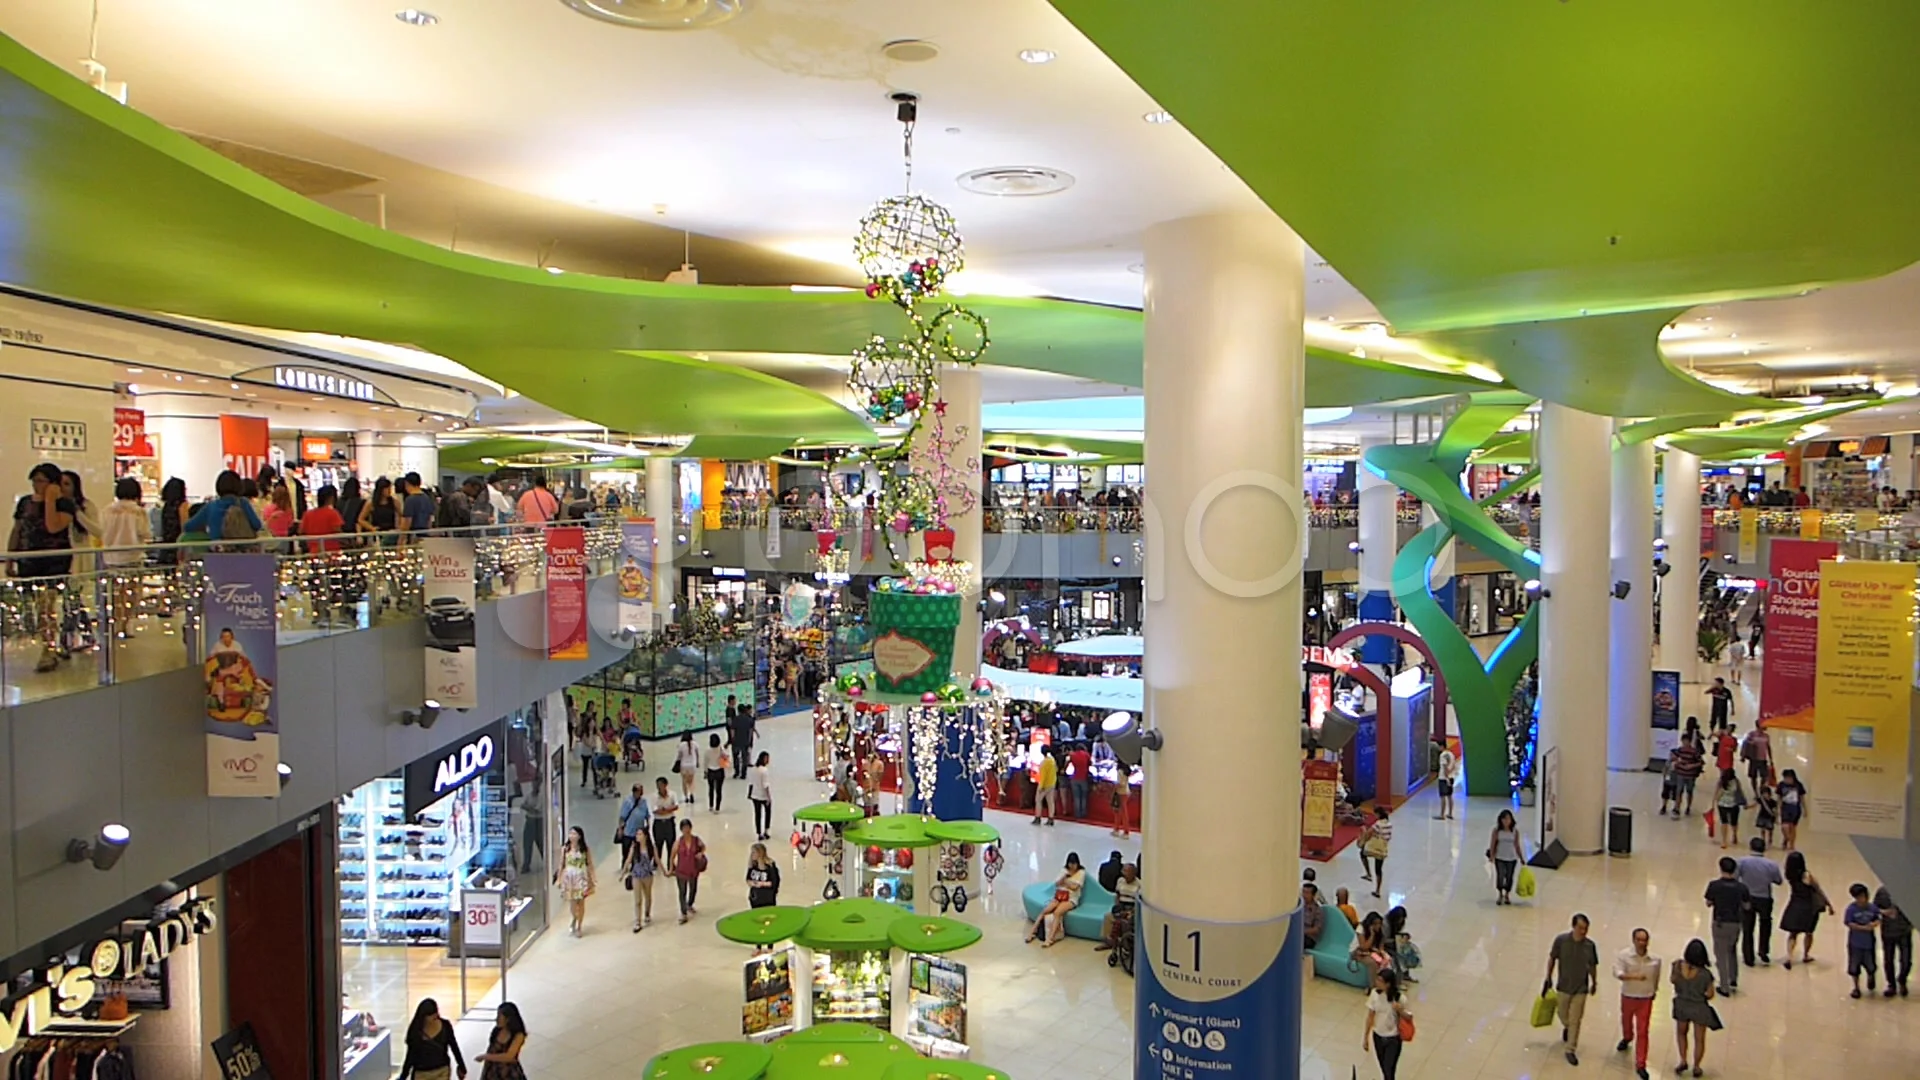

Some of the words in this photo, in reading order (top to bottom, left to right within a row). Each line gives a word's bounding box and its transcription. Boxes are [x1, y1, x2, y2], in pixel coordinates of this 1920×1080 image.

[275, 367, 336, 393] LOWRYS
[338, 379, 375, 399] FARM
[33, 423, 83, 436] LOWRYS
[428, 555, 452, 567] Win
[434, 567, 467, 579] Lexus
[206, 582, 217, 595] A
[215, 583, 262, 604] Touch
[1864, 581, 1880, 591] Up
[235, 605, 269, 619] Magic
[434, 736, 494, 792] ALDO
[122, 898, 217, 979] LADY'S
[1162, 923, 1201, 972] L1
[1163, 969, 1203, 985] CENTRAL
[1208, 978, 1243, 987] COURT
[1162, 1007, 1203, 1022] Vivomart
[1206, 1017, 1241, 1029] (Giant)
[1162, 1062, 1181, 1076] MRT
[1176, 1055, 1232, 1070] Information
